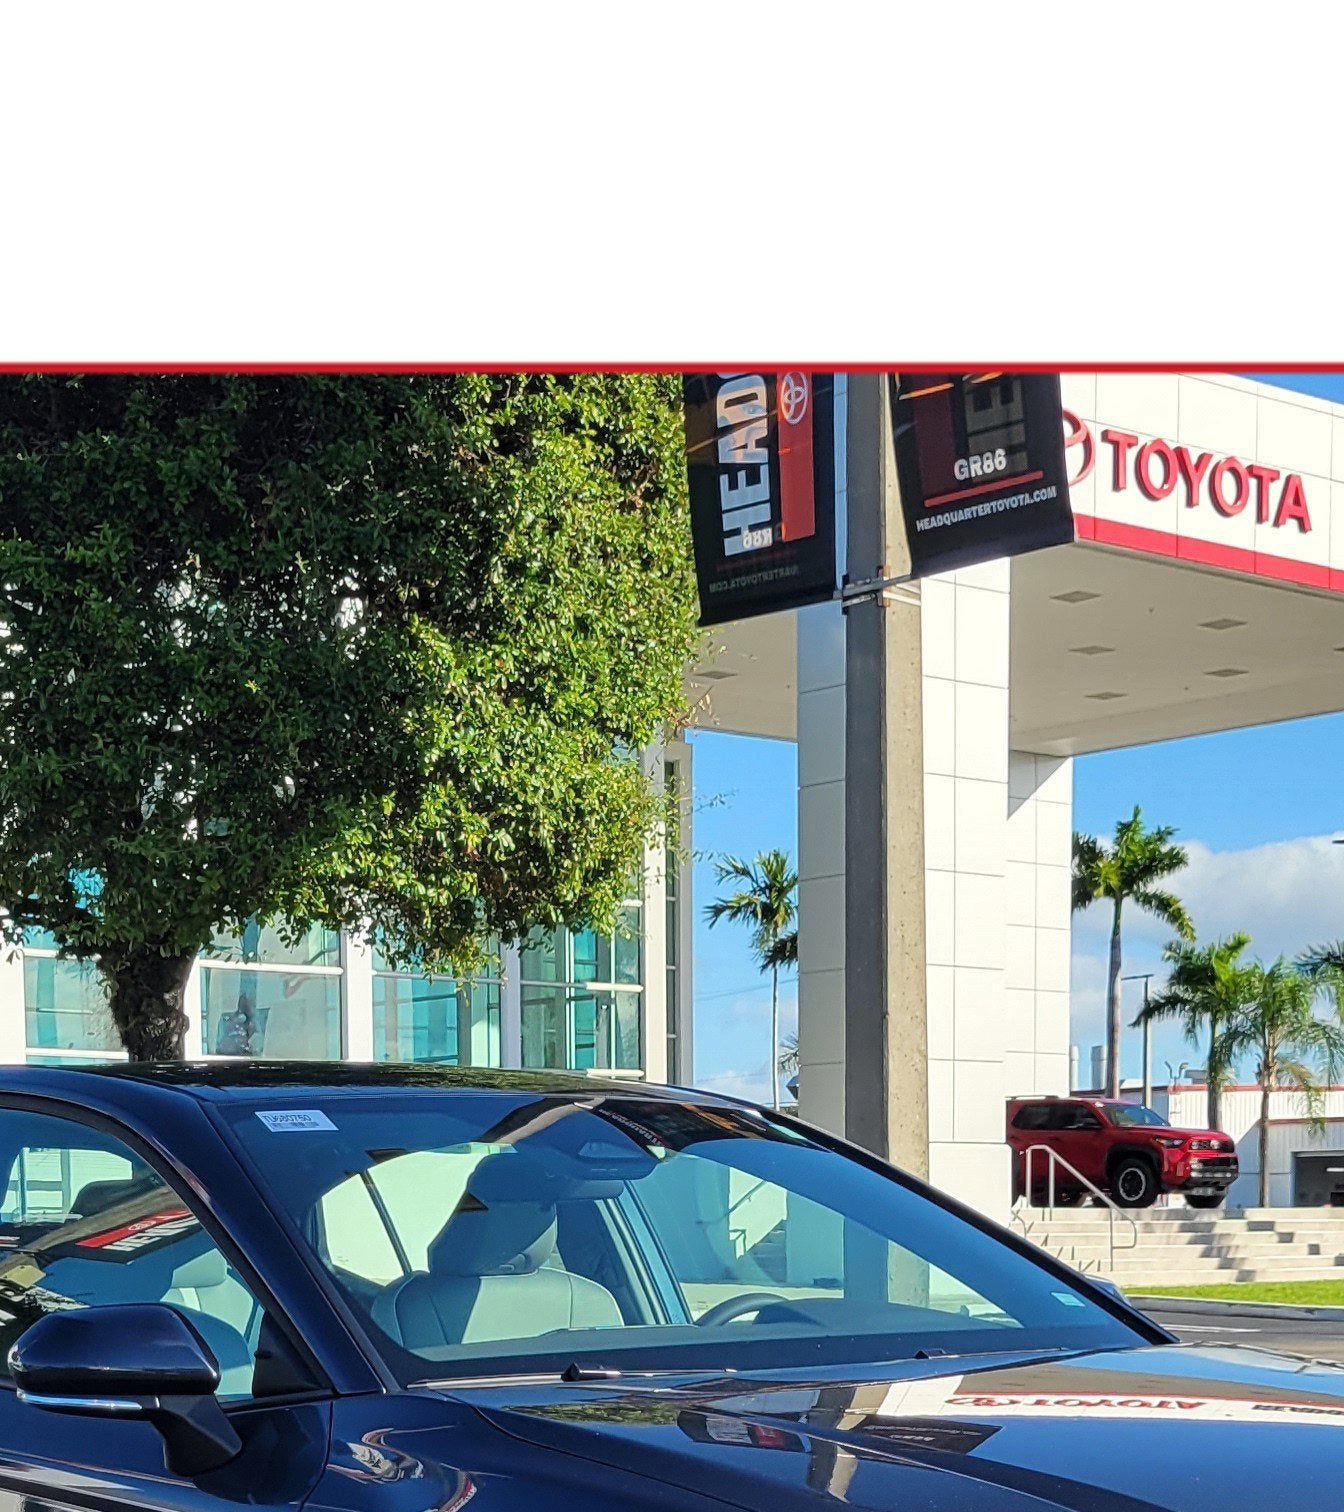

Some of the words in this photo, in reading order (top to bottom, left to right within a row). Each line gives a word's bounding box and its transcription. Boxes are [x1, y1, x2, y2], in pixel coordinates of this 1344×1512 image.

[715, 371, 774, 557] HEAD
[953, 448, 1008, 482] GR86
[1103, 428, 1313, 533] TOYOTA
[915, 485, 1058, 532] HEADQUARTERTOYOTA.COM
